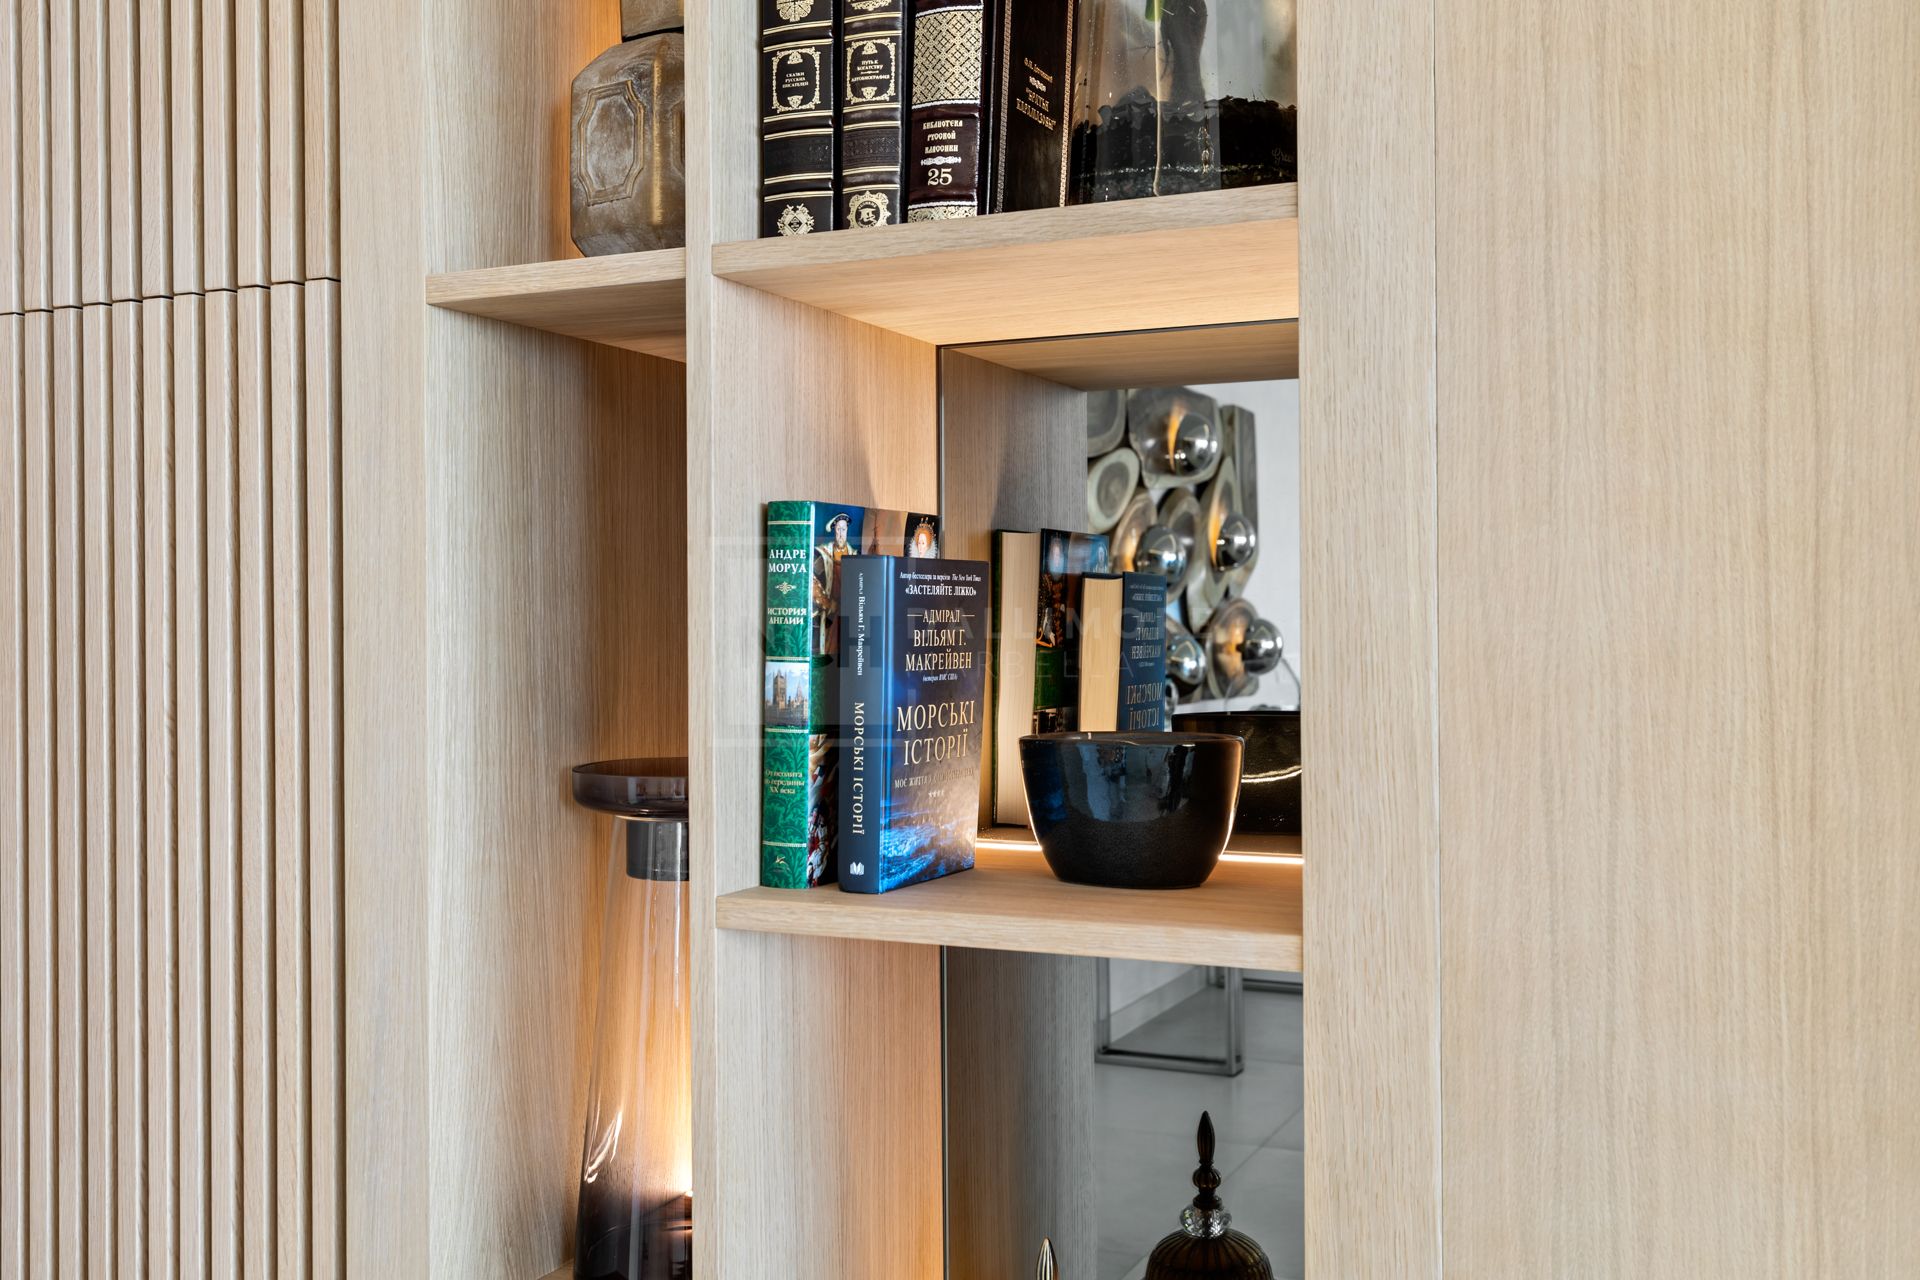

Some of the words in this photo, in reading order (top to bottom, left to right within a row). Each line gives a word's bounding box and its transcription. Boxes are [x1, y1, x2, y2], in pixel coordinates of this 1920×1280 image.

[923, 120, 963, 130] БИБЛИОТЕКА
[927, 168, 953, 186] 25
[769, 549, 807, 560] АНДРЕ
[768, 563, 807, 574] МОРУА
[905, 583, 953, 596] «ЗАСТЕЛЯЙТЕ
[767, 607, 807, 616] ИСТОРИЯ
[922, 609, 961, 624] АДМІРАЛ
[769, 616, 804, 625] АНГЛИИ
[913, 629, 956, 647] ВІЛЬЯМ
[905, 648, 972, 672] МАКРЕЙВЕН
[896, 700, 975, 732] МОРСЬКІ
[853, 702, 865, 771] МОРСЬКІ
[903, 728, 968, 766] ІСТОРІЇ
[852, 777, 865, 835] ІСТОРІЇ
